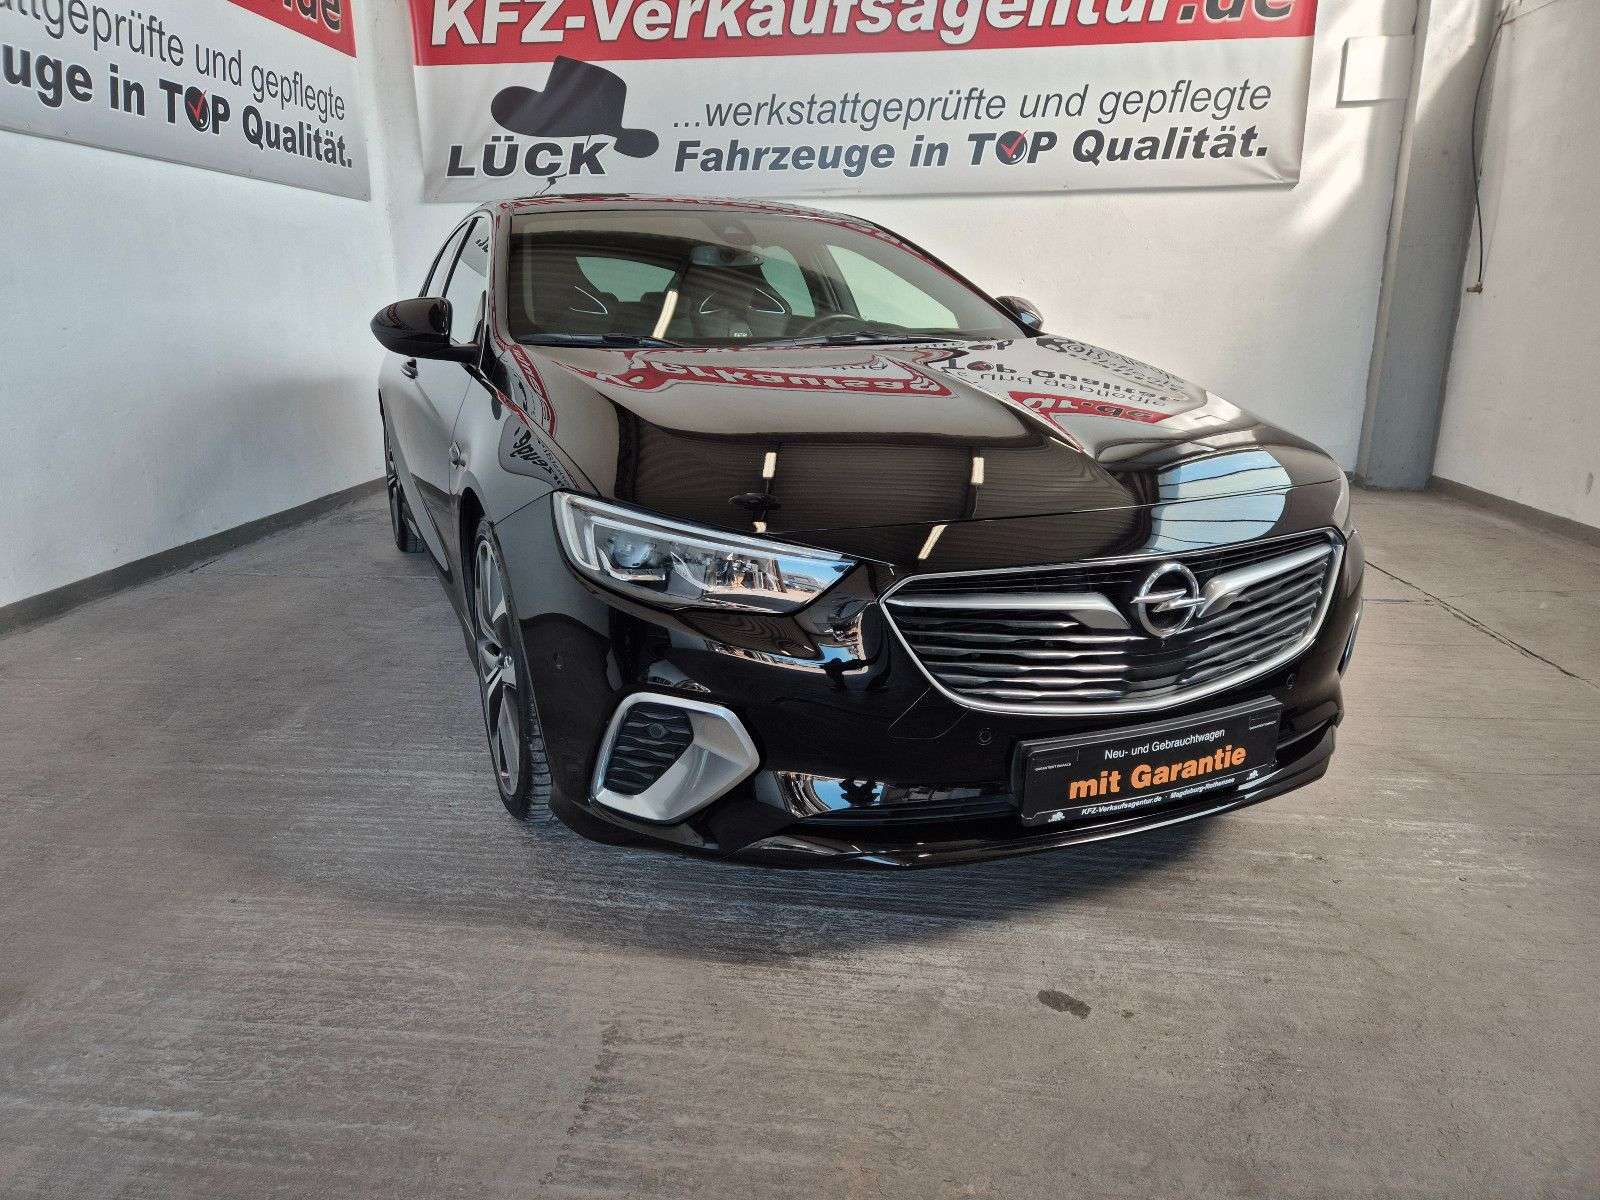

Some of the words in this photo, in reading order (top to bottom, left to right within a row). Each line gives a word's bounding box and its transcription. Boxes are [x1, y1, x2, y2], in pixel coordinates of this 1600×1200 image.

[0, 0, 184, 67] geprüfte
[195, 43, 242, 86] und
[251, 64, 345, 123] gepflegte
[2, 43, 93, 108] uge
[109, 62, 145, 117] in
[159, 77, 230, 134] TOP
[242, 104, 353, 168] Qualität.
[673, 86, 1006, 131] ...werkstattgeprüfte
[1018, 83, 1089, 120] und
[1099, 79, 1272, 124] gepflegte
[446, 135, 608, 178] LÜCK
[674, 139, 896, 178] Fahrzeuge
[909, 134, 949, 167] in
[967, 129, 1058, 166] TOP
[1072, 124, 1268, 168] Qualität.
[1104, 748, 1129, 761] Neu-
[1131, 743, 1150, 757] und
[1151, 728, 1226, 752] Gebrauchtwagen
[1069, 770, 1122, 800] mit
[1130, 744, 1248, 790] Garantie
[1081, 796, 1163, 816] KFZ-Verkaufsagentur.de
